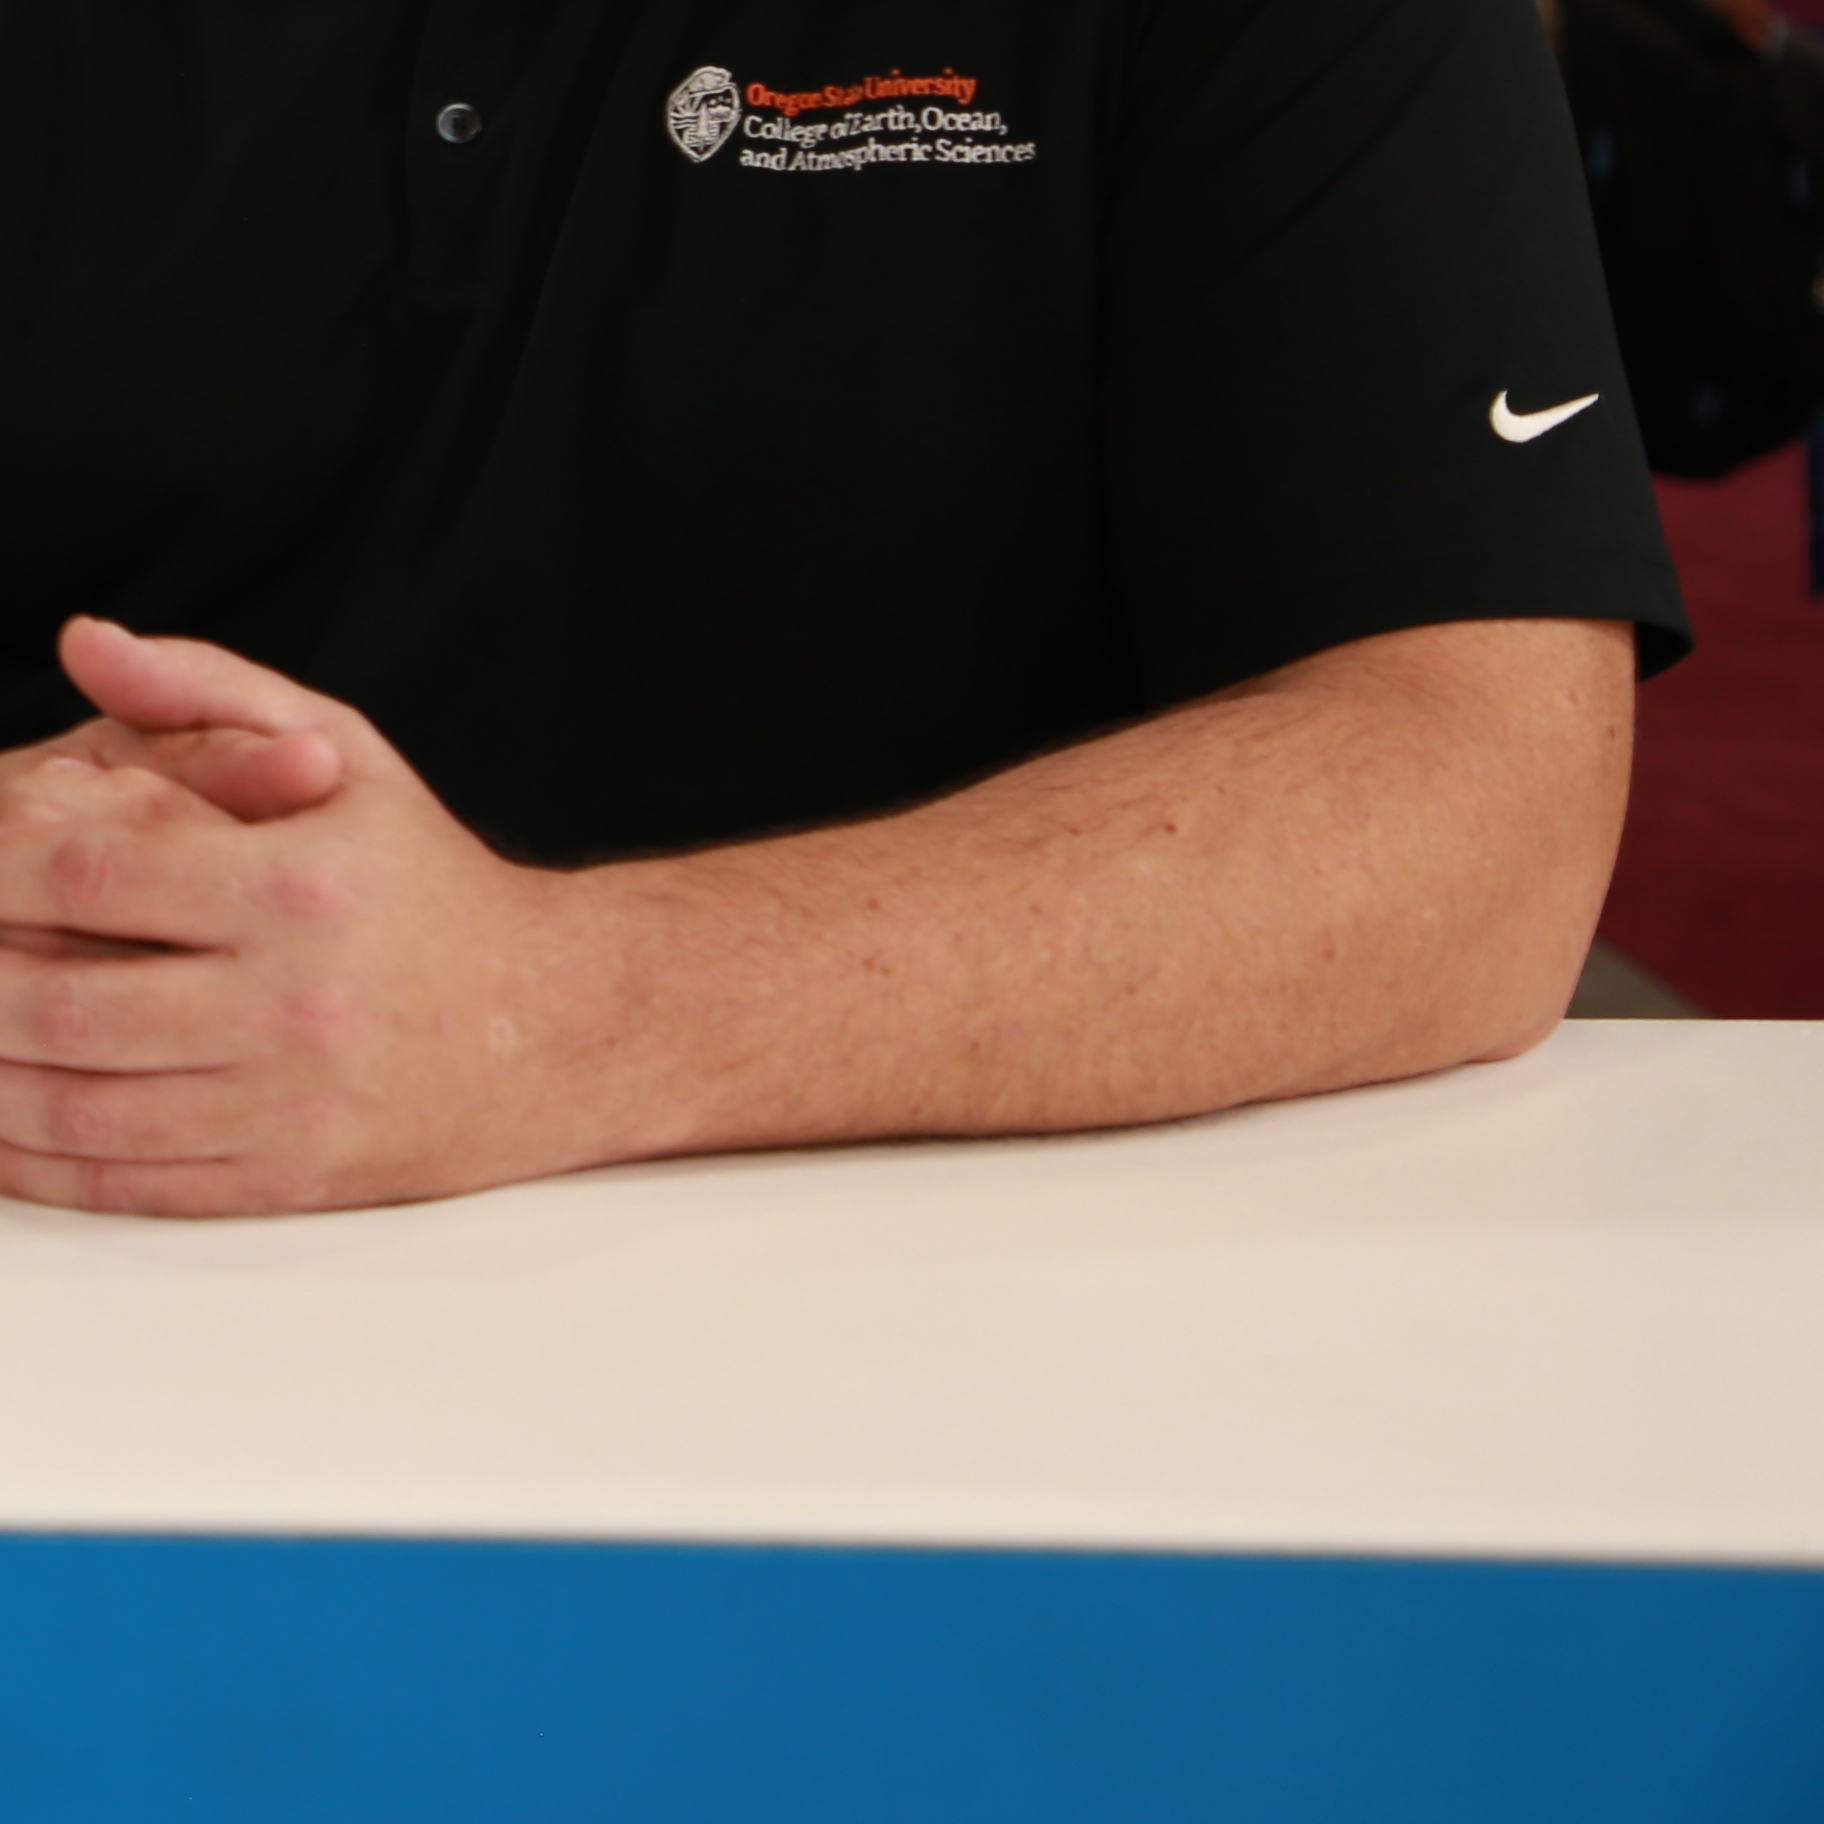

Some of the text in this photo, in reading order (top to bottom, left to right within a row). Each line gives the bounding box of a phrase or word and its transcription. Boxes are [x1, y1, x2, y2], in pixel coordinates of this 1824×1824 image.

[864, 67, 978, 105] University
[743, 115, 829, 149] College
[920, 107, 1008, 136] Ocean,
[739, 137, 1037, 171] and Atmospheric Sciences
